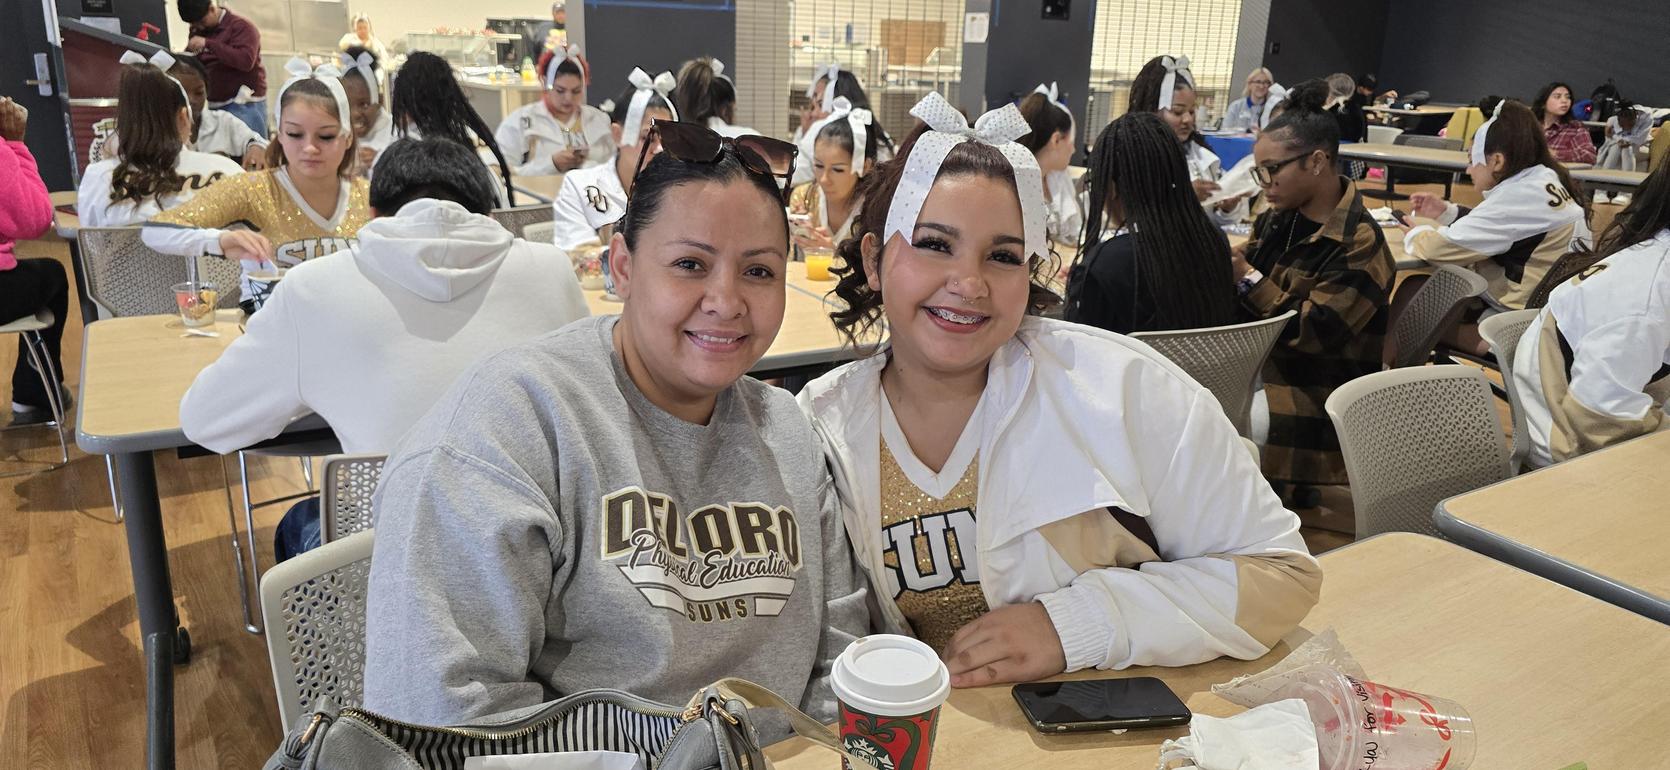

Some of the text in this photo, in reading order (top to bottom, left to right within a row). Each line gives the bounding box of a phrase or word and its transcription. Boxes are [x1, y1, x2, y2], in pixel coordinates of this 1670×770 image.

[700, 549, 790, 590] Education
[686, 597, 749, 623] SUNS
[1363, 706, 1377, 733] for
